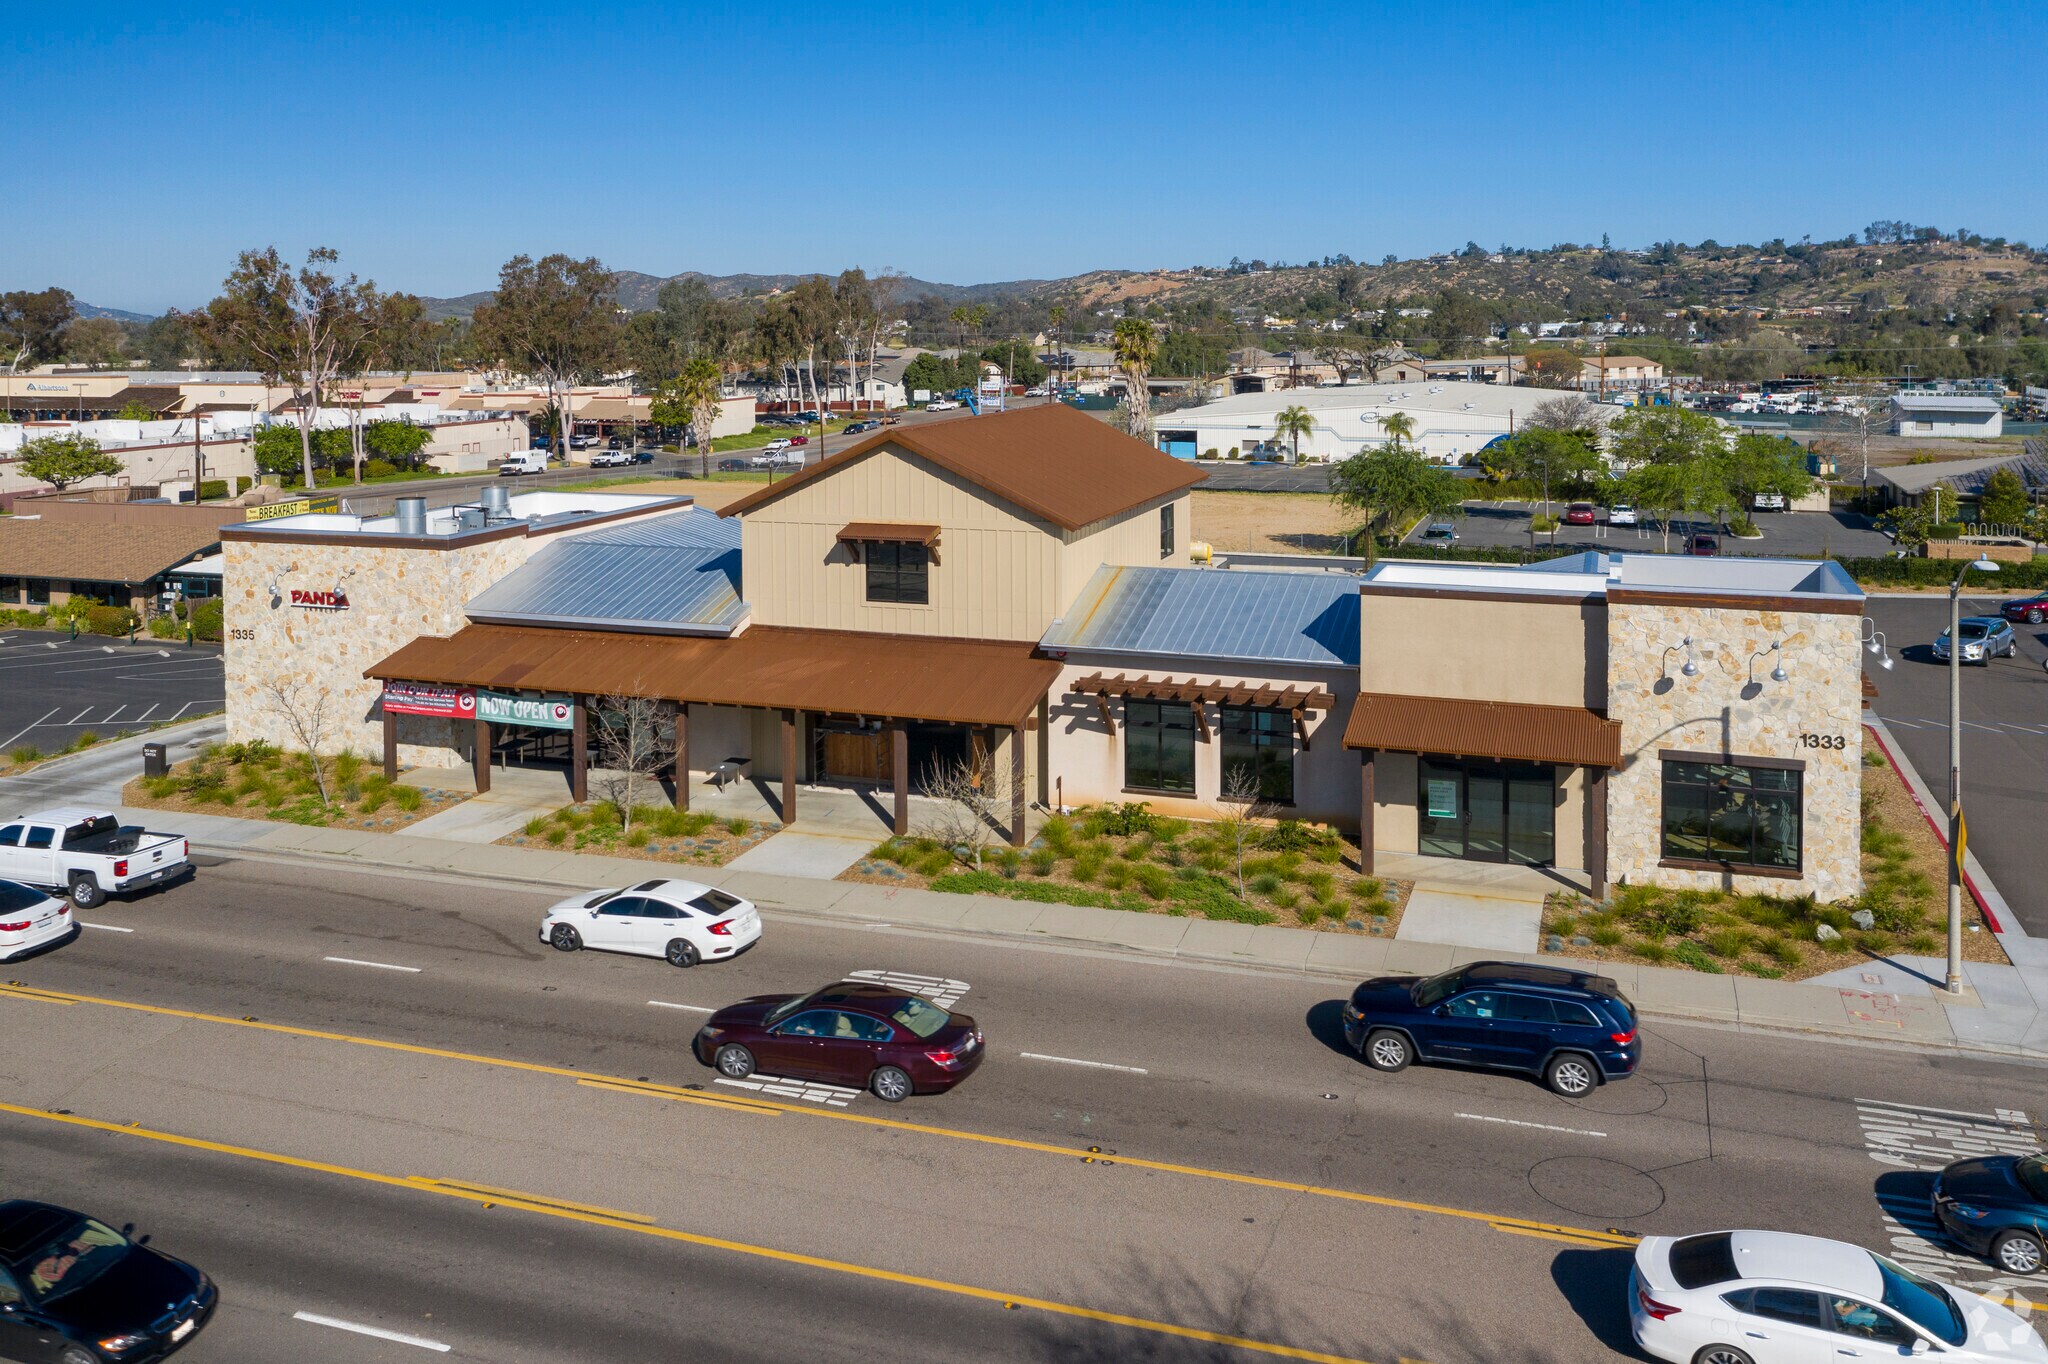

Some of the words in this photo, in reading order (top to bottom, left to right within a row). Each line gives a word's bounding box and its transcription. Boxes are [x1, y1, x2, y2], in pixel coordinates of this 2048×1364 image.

[259, 503, 298, 519] BREAKFAST
[290, 589, 350, 606] PANDA
[230, 629, 255, 640] 1335
[385, 683, 406, 693] JOIN
[409, 686, 429, 696] OUR
[431, 688, 456, 698] TEAM
[481, 695, 511, 715] NOW
[514, 701, 548, 719] OPEN
[1799, 733, 1846, 751] 1333
